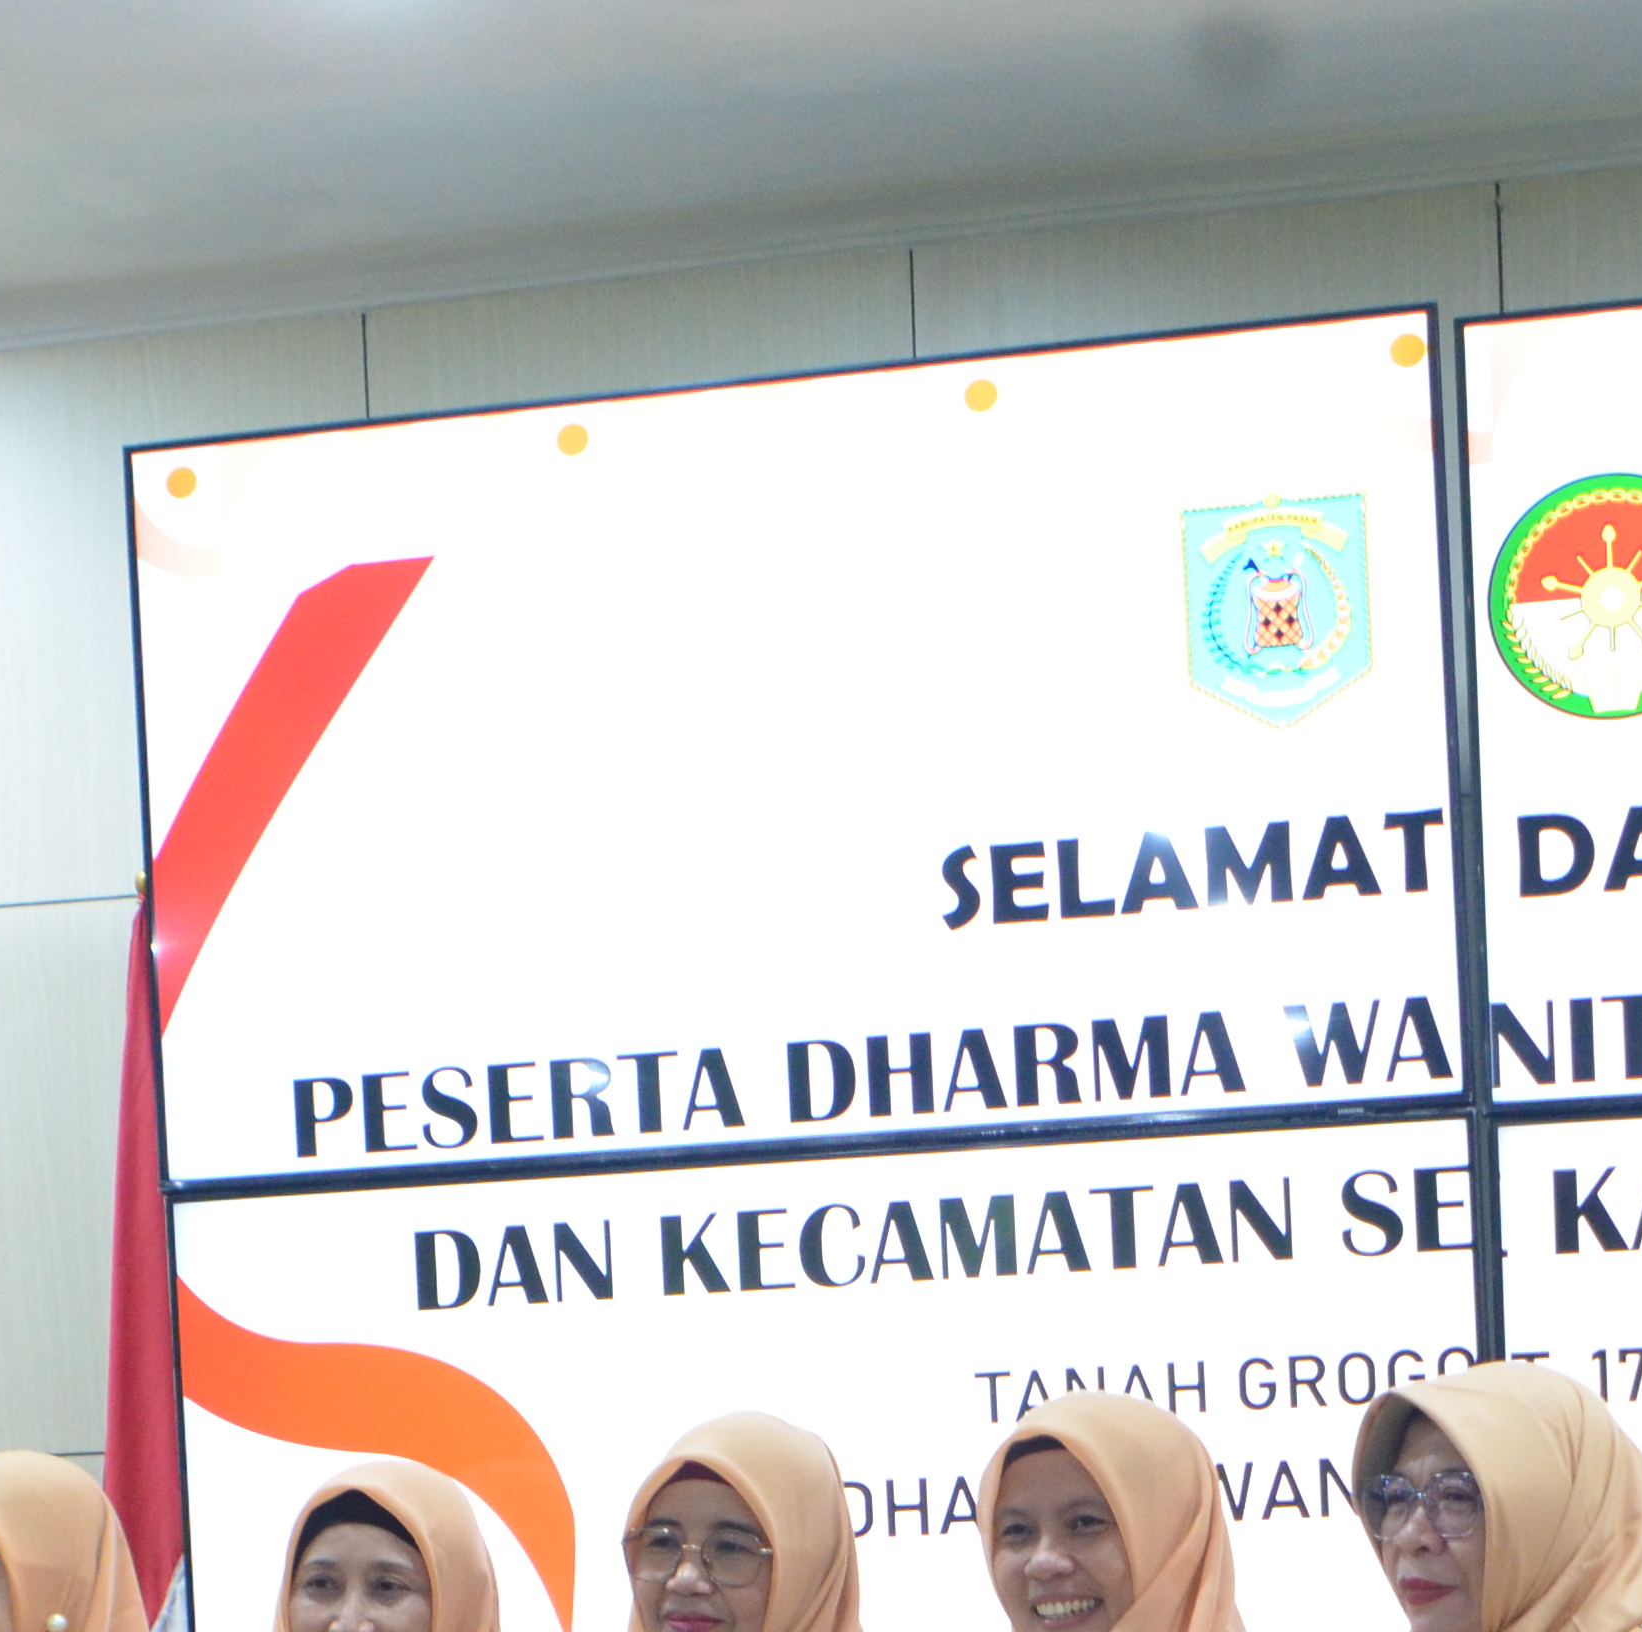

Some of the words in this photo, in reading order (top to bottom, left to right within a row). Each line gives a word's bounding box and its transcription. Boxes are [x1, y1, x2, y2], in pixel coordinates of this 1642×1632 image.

[941, 807, 1444, 931] SELAMAT
[293, 1047, 746, 1158] PESERTA
[787, 1011, 1247, 1123] DHARMA
[414, 1219, 614, 1311] DAN
[660, 1176, 1294, 1296] KECAMATAN
